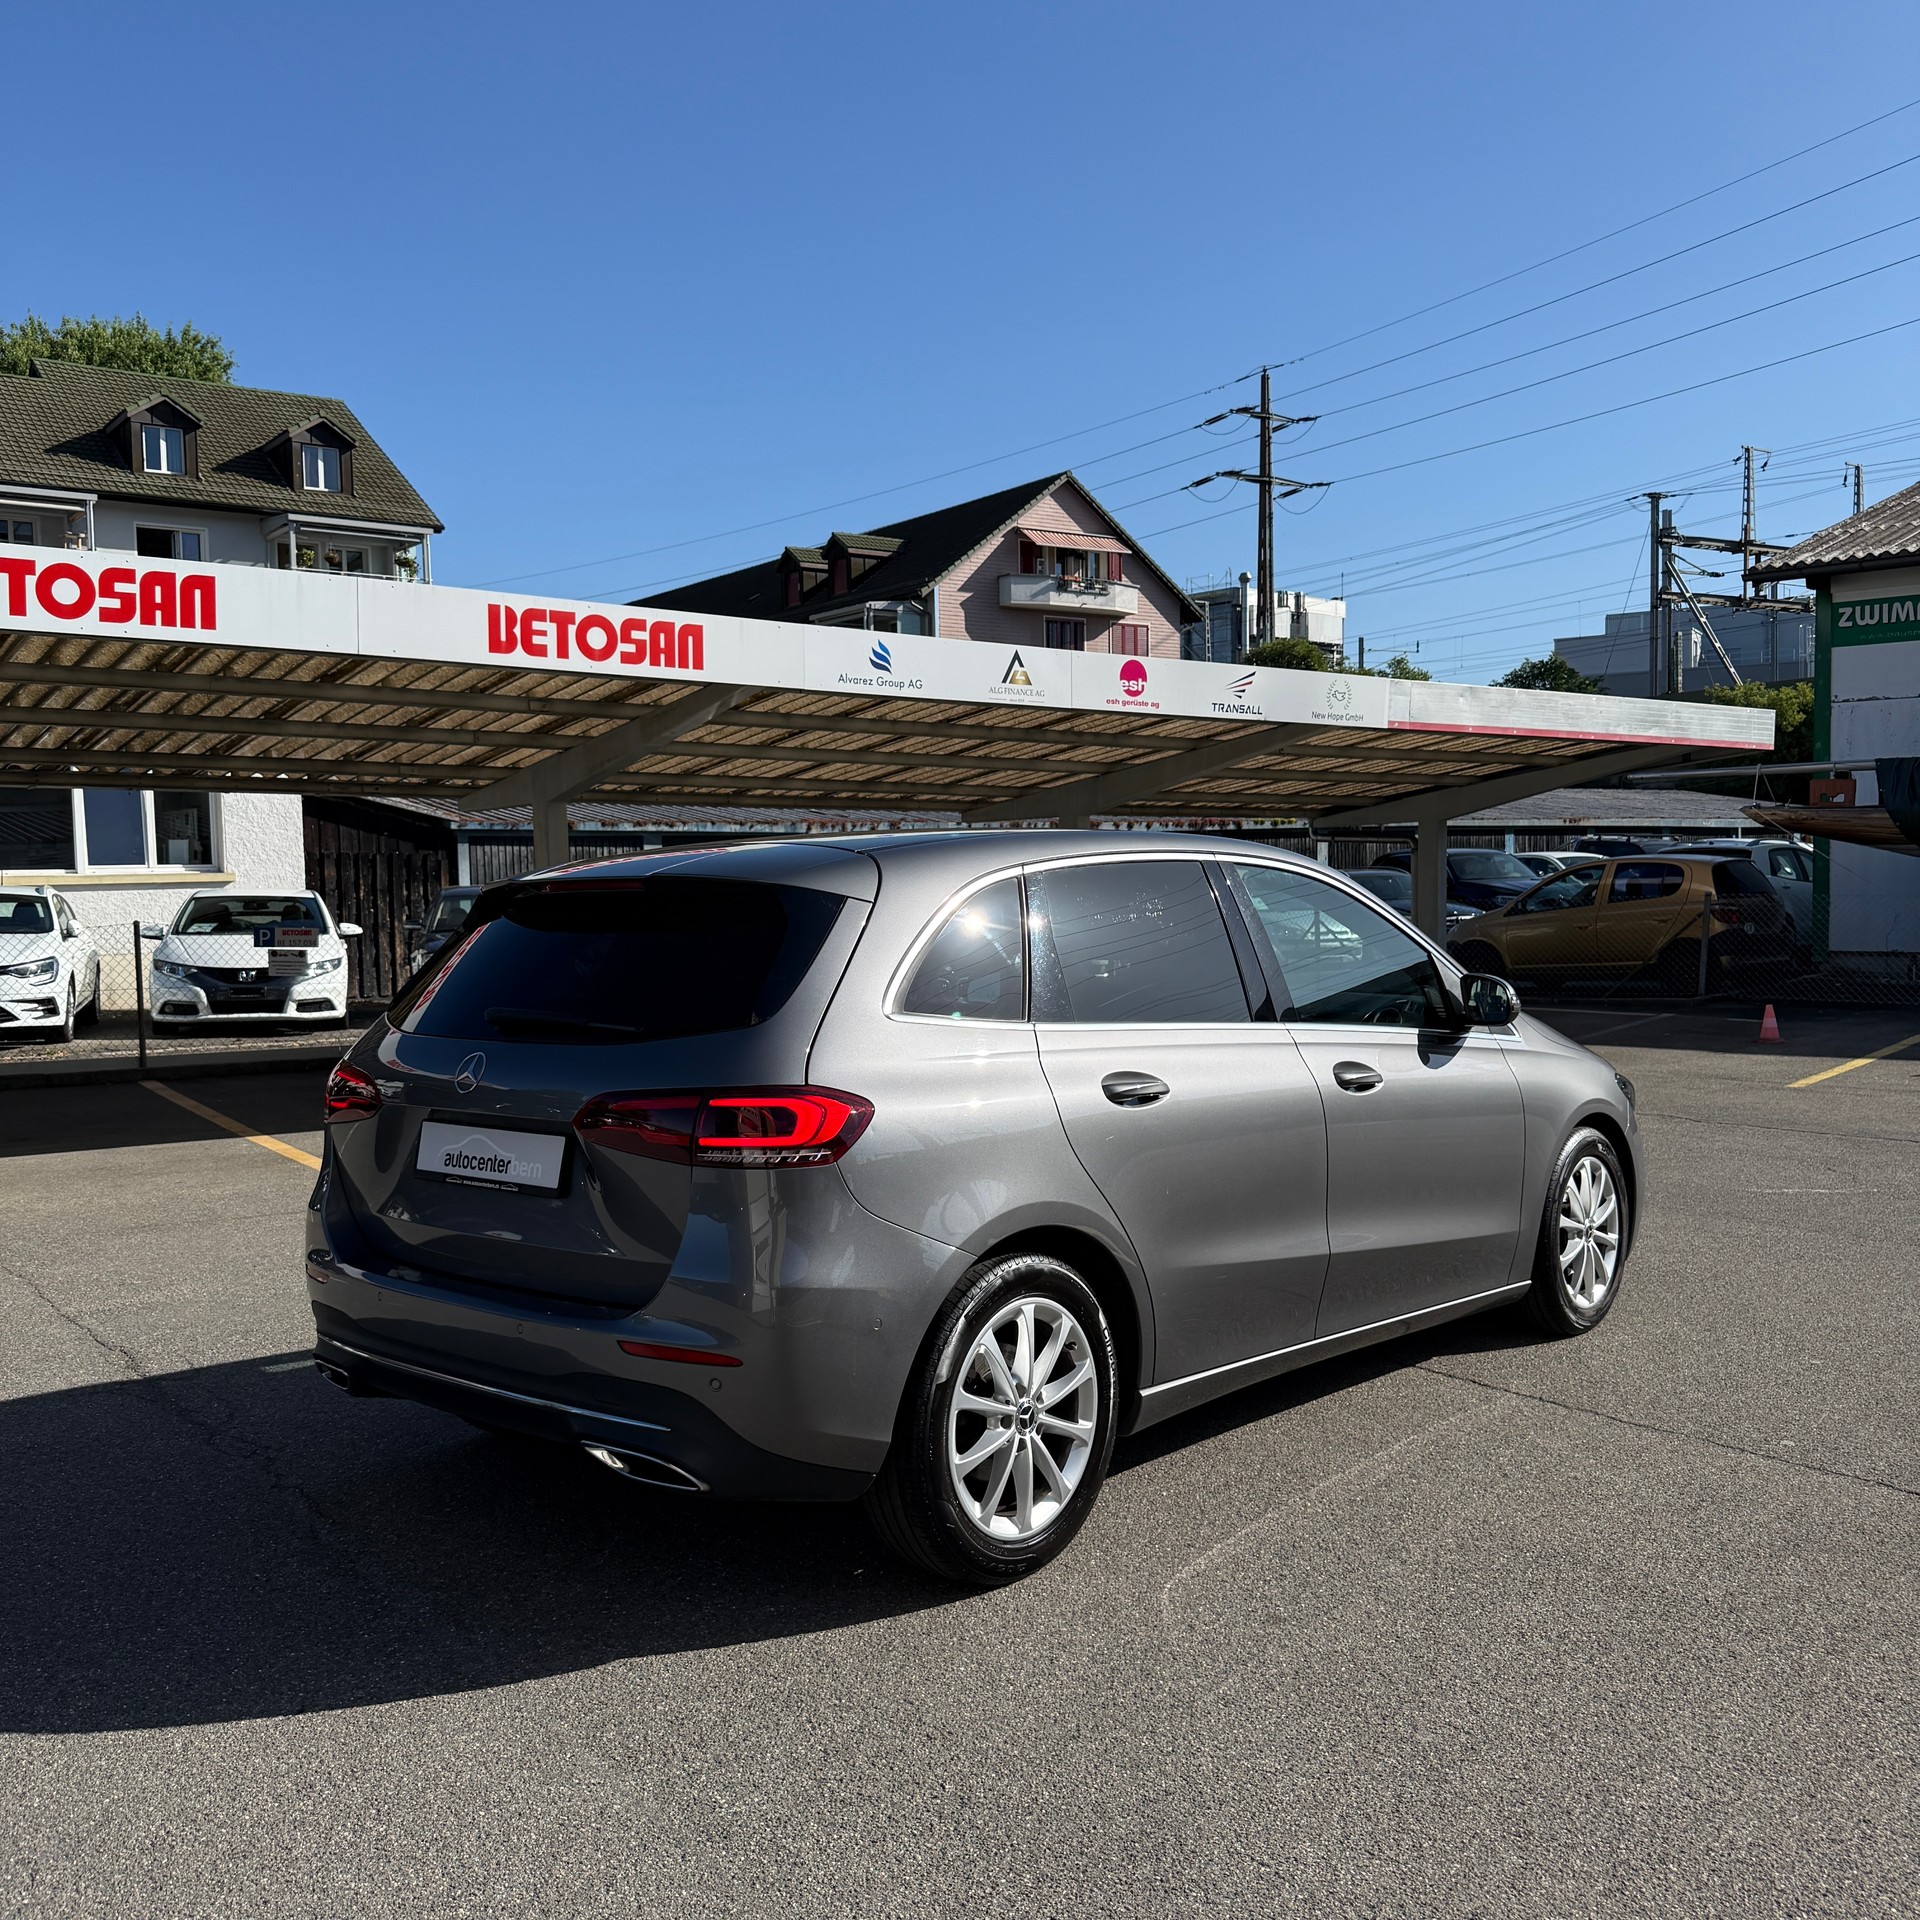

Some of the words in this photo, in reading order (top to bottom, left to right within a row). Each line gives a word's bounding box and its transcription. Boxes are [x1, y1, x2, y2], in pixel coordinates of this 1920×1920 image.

[1838, 601, 1920, 628] ZWIM
[487, 603, 704, 671] BETOSAN
[837, 672, 874, 686] Alvarez
[876, 676, 905, 691] Group
[907, 679, 923, 690] AG
[988, 686, 1004, 695] ALG
[1004, 687, 1034, 697] FINANCE
[1035, 689, 1045, 697] AG
[1121, 699, 1149, 708] gerüste
[1211, 702, 1263, 715] TRANSALL
[1311, 711, 1326, 720] New
[1327, 712, 1344, 722] Hope
[1345, 712, 1364, 722] GmbH
